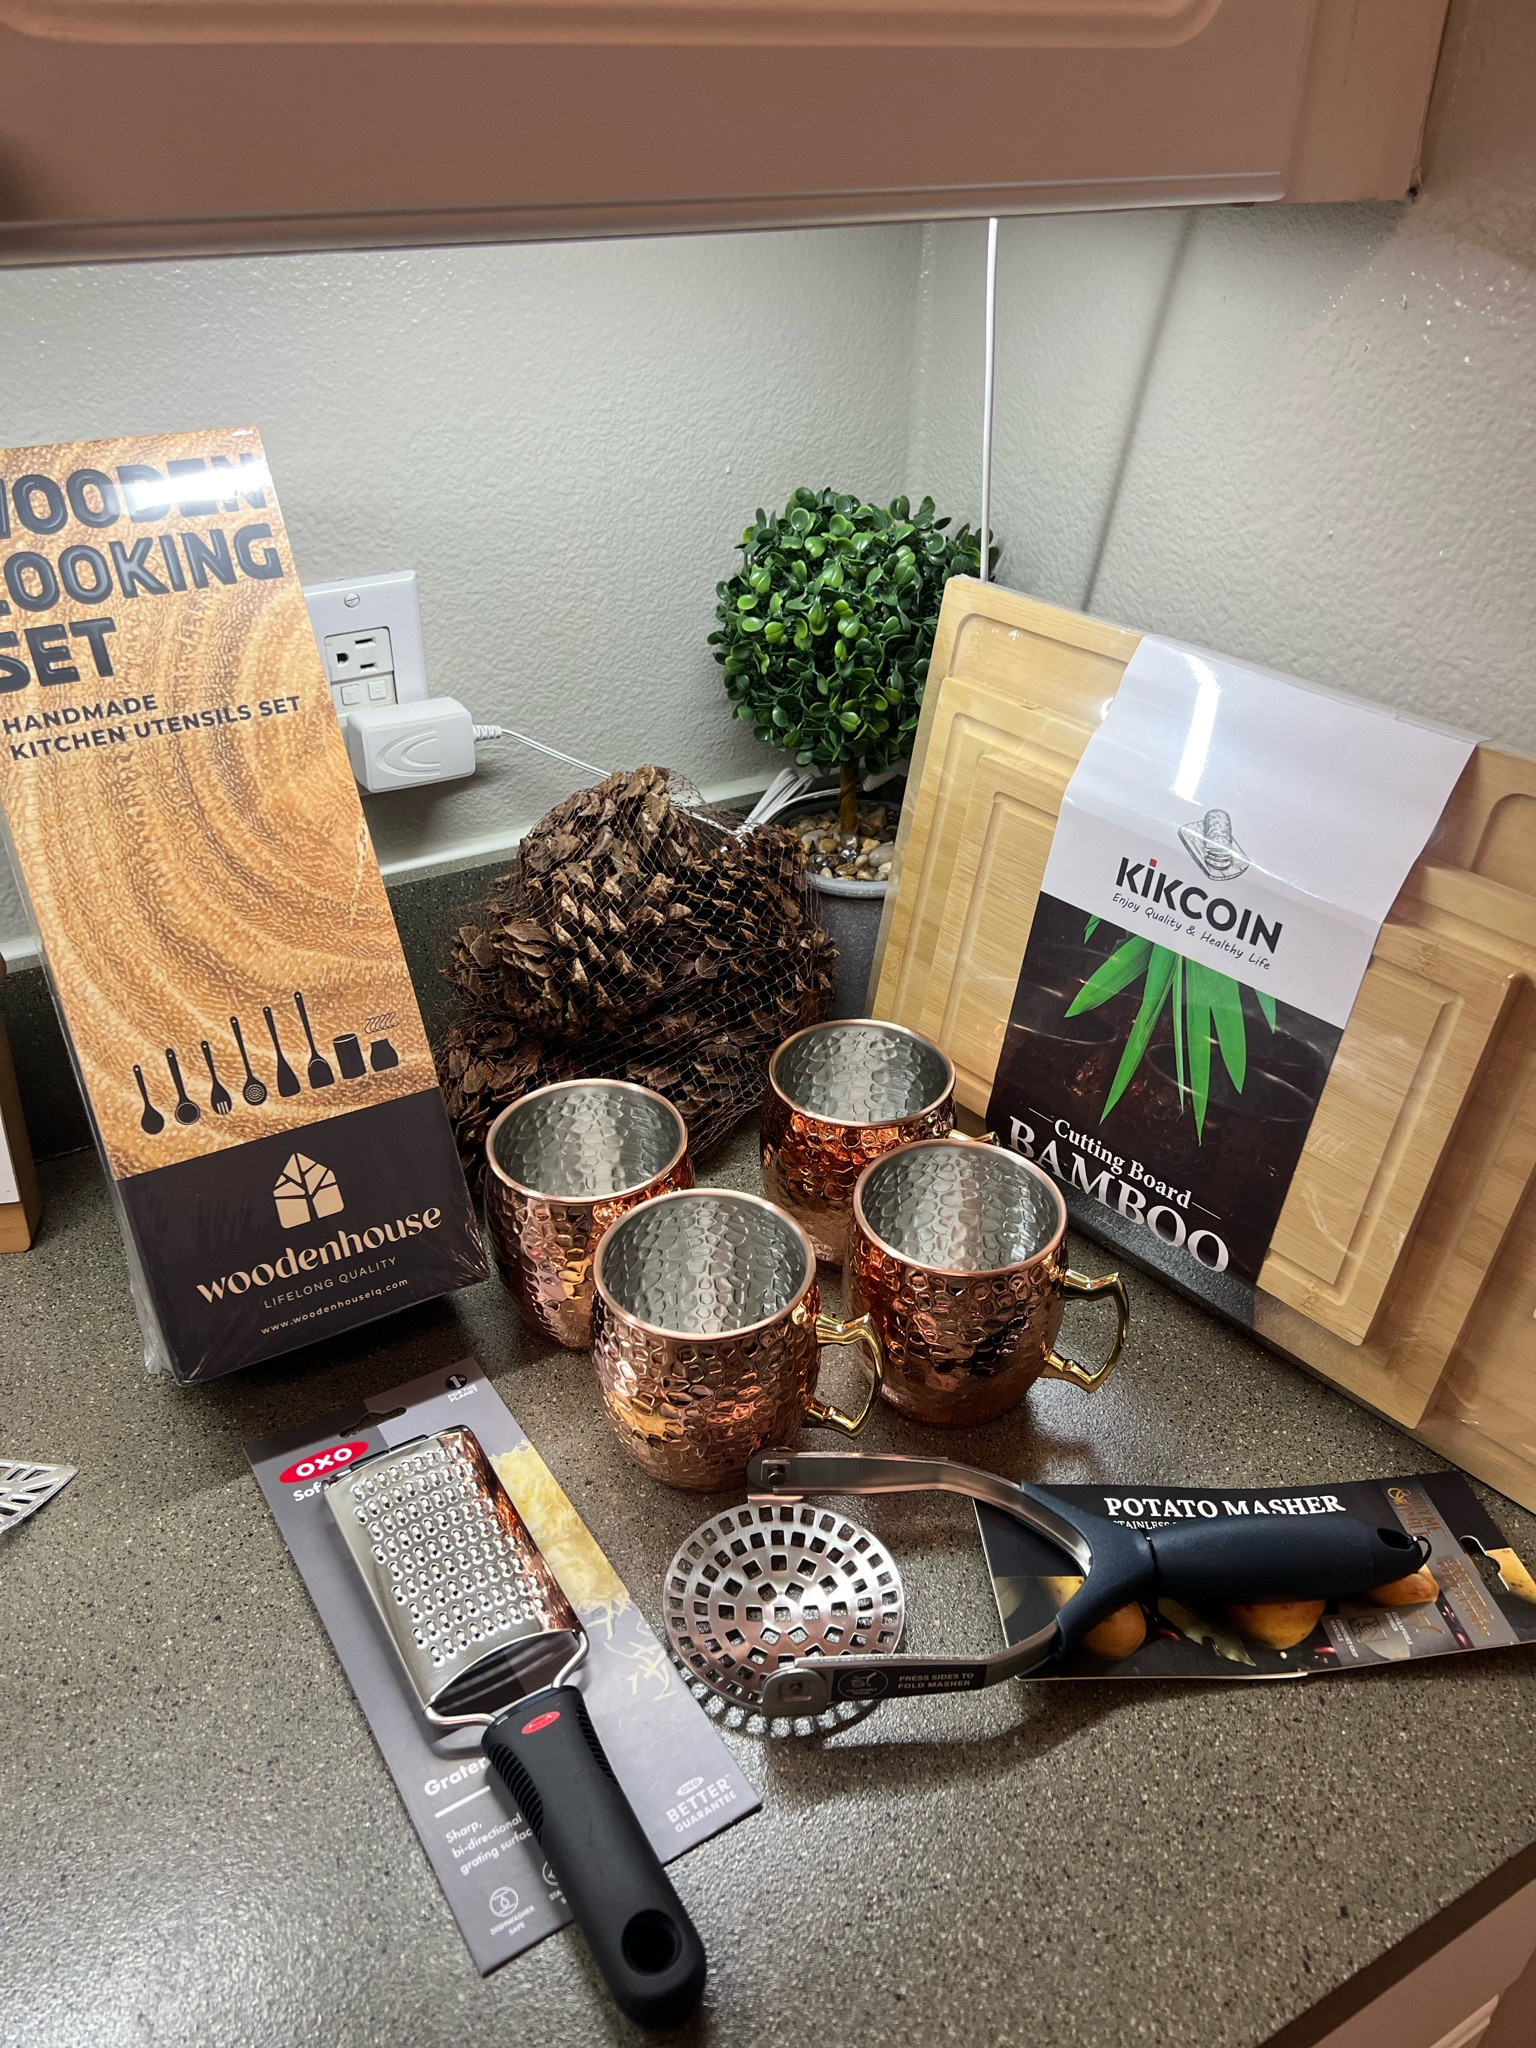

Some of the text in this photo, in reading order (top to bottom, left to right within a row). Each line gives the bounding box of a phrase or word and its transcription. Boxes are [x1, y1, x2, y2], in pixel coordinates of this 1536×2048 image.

[0, 523, 284, 616] OOKING
[0, 617, 116, 693] SET
[2, 694, 158, 735] HANDMADE
[10, 695, 301, 761] KITCHEN UTENSILS SET
[1112, 892, 1271, 970] Enjoy Quality & Healthy Life
[1054, 1118, 1192, 1211] Cutting Board
[1007, 1115, 1230, 1273] BAMBOO
[196, 1206, 443, 1304] woodenhouse
[263, 1256, 398, 1310] LIFELONG QUALITY
[260, 1279, 410, 1336] www.woodenhouselq.com
[449, 1388, 479, 1403] PLANET
[295, 1447, 353, 1477] OXO
[293, 1481, 322, 1502] Sof
[1103, 1495, 1347, 1518] POTATO MASHER
[1113, 1520, 1170, 1530] TAINLESS
[897, 1678, 972, 1690] FOLD MASHER
[898, 1672, 975, 1683] PRESS SIDES TO
[424, 1756, 488, 1796] Grater
[665, 1778, 731, 1824] BETTER
[674, 1789, 737, 1833] GUARANTEE
[445, 1820, 483, 1844] Sharp,
[451, 1811, 523, 1859] bi-directional
[460, 1827, 533, 1876] grating surfac
